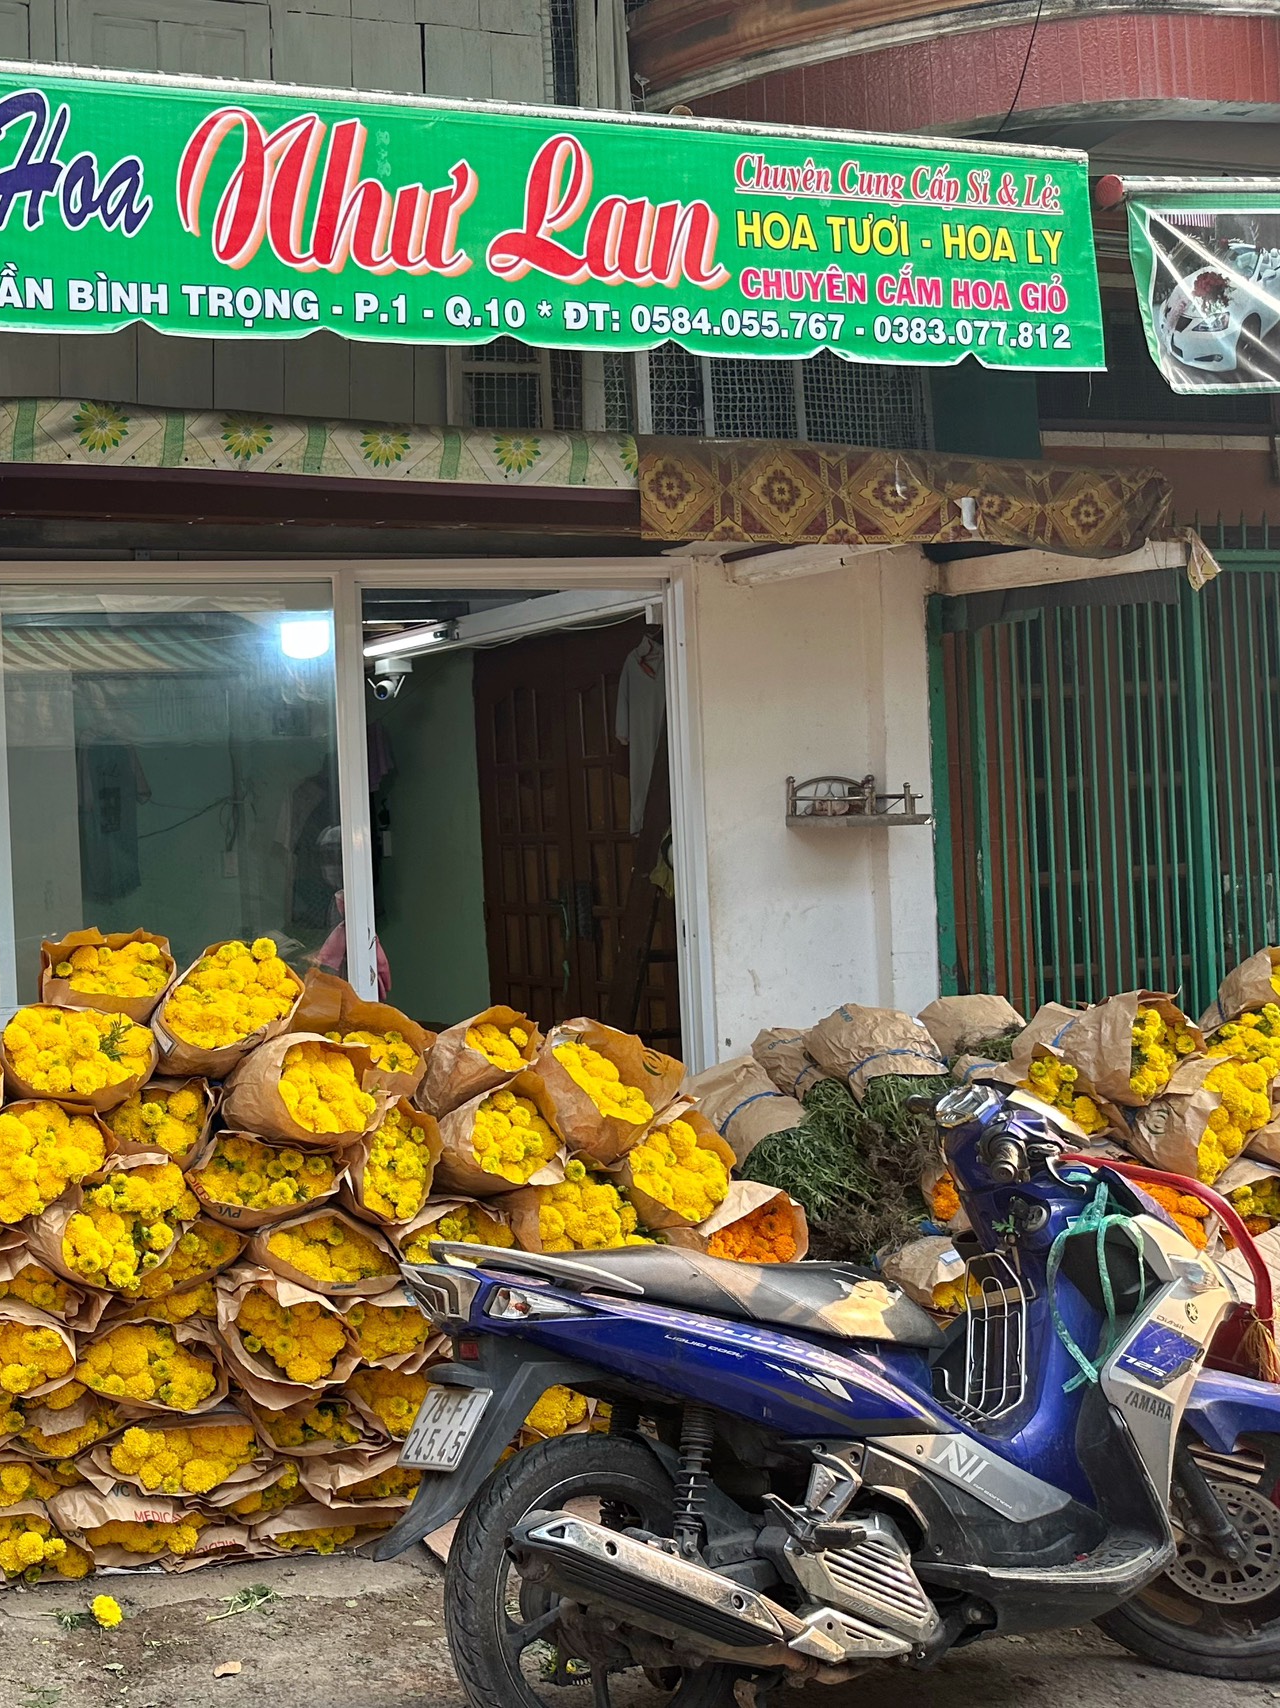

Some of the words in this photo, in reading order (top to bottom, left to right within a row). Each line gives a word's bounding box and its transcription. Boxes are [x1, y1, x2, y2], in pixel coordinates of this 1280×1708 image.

[176, 106, 480, 275] Như
[486, 132, 731, 290] Lan
[734, 152, 831, 201] Chuyên
[838, 161, 903, 202] Cung
[911, 163, 960, 209] Cấp
[967, 169, 990, 205] Sỉ
[996, 176, 1017, 207] &
[1023, 174, 1061, 210] Lẻ:
[736, 211, 818, 251] HOA
[827, 215, 910, 257] TƯƠI
[942, 225, 1018, 263] HOA
[1027, 229, 1064, 265] LY
[69, 269, 169, 316] BÌNH
[180, 285, 320, 327] TRỌNG
[354, 298, 410, 325] P.1
[445, 299, 523, 330] Q.10
[563, 302, 621, 333] ĐT:
[631, 303, 845, 342] 0584.055.767
[873, 320, 1072, 350] 0383.077.812
[740, 265, 868, 304] CHUYÊN
[876, 263, 943, 308] CẮM
[952, 281, 1011, 311] HOA
[1018, 274, 1069, 314] GIỎ
[1122, 1354, 1167, 1377] 125
[1124, 1390, 1172, 1420] YAMAHA
[404, 1428, 466, 1463] 245.45
